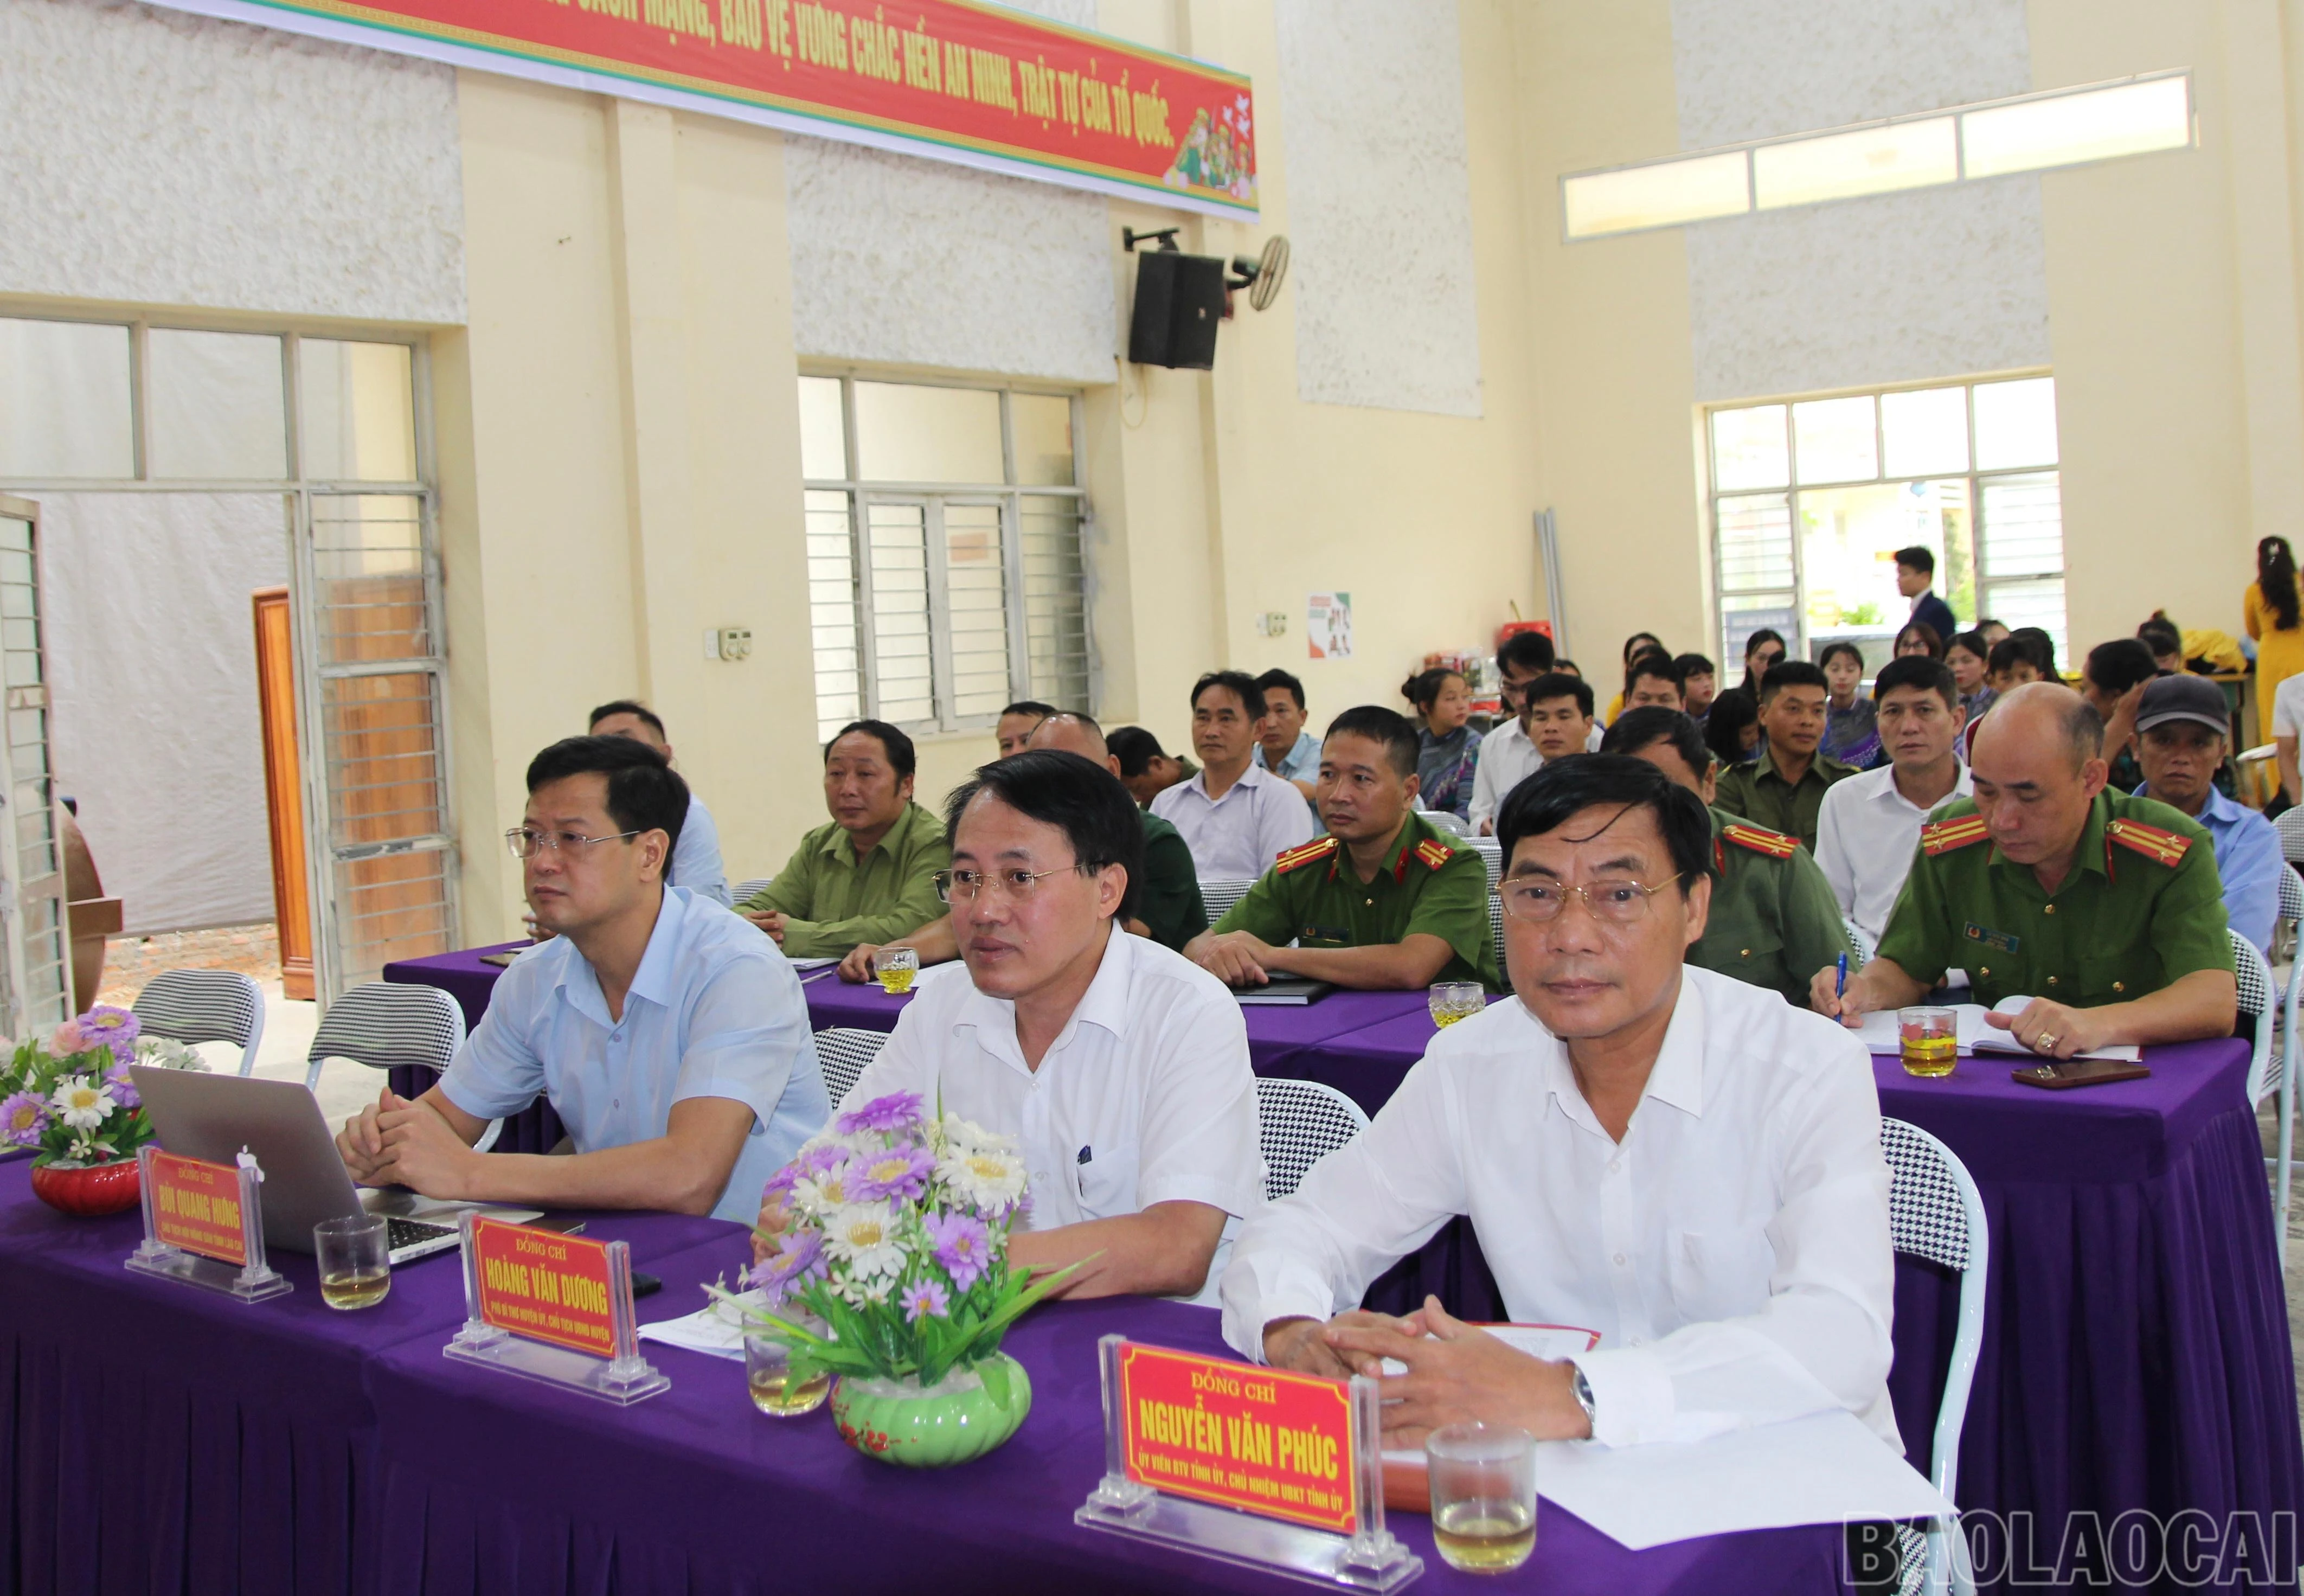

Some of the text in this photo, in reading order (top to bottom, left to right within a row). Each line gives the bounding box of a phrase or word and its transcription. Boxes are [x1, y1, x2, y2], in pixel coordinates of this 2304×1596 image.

[850, 4, 901, 84] CHẮC
[902, 14, 942, 93] NỀN
[944, 40, 970, 100] AN
[970, 47, 1018, 118] NINH,
[1017, 54, 1057, 130] TRẬT
[1057, 69, 1080, 137] TỰ
[1080, 57, 1113, 134] CỦA
[1112, 68, 1132, 139] TỔ
[1133, 78, 1175, 149] QUỐC.
[158, 1180, 176, 1214] BÙI
[177, 1189, 210, 1222] QUANG
[516, 1234, 567, 1260] ĐỒNG CHÍ
[485, 1254, 608, 1316] HOÀNG VĂN DƯƠNG
[1191, 1367, 1276, 1405] ĐỒNG CHÍ
[1139, 1393, 1338, 1480] NGUYỄN VĂN PHÚC
[1151, 1453, 1171, 1473] VIÊN
[1173, 1459, 1189, 1477] BTV
[1191, 1458, 1211, 1483] TỈNH
[1228, 1467, 1247, 1491] CHỦ
[1248, 1476, 1279, 1499] NHIỆM
[1281, 1483, 1304, 1503] UBKT
[1306, 1484, 1329, 1509] TỈNH
[1330, 1487, 1343, 1512] ỦY
